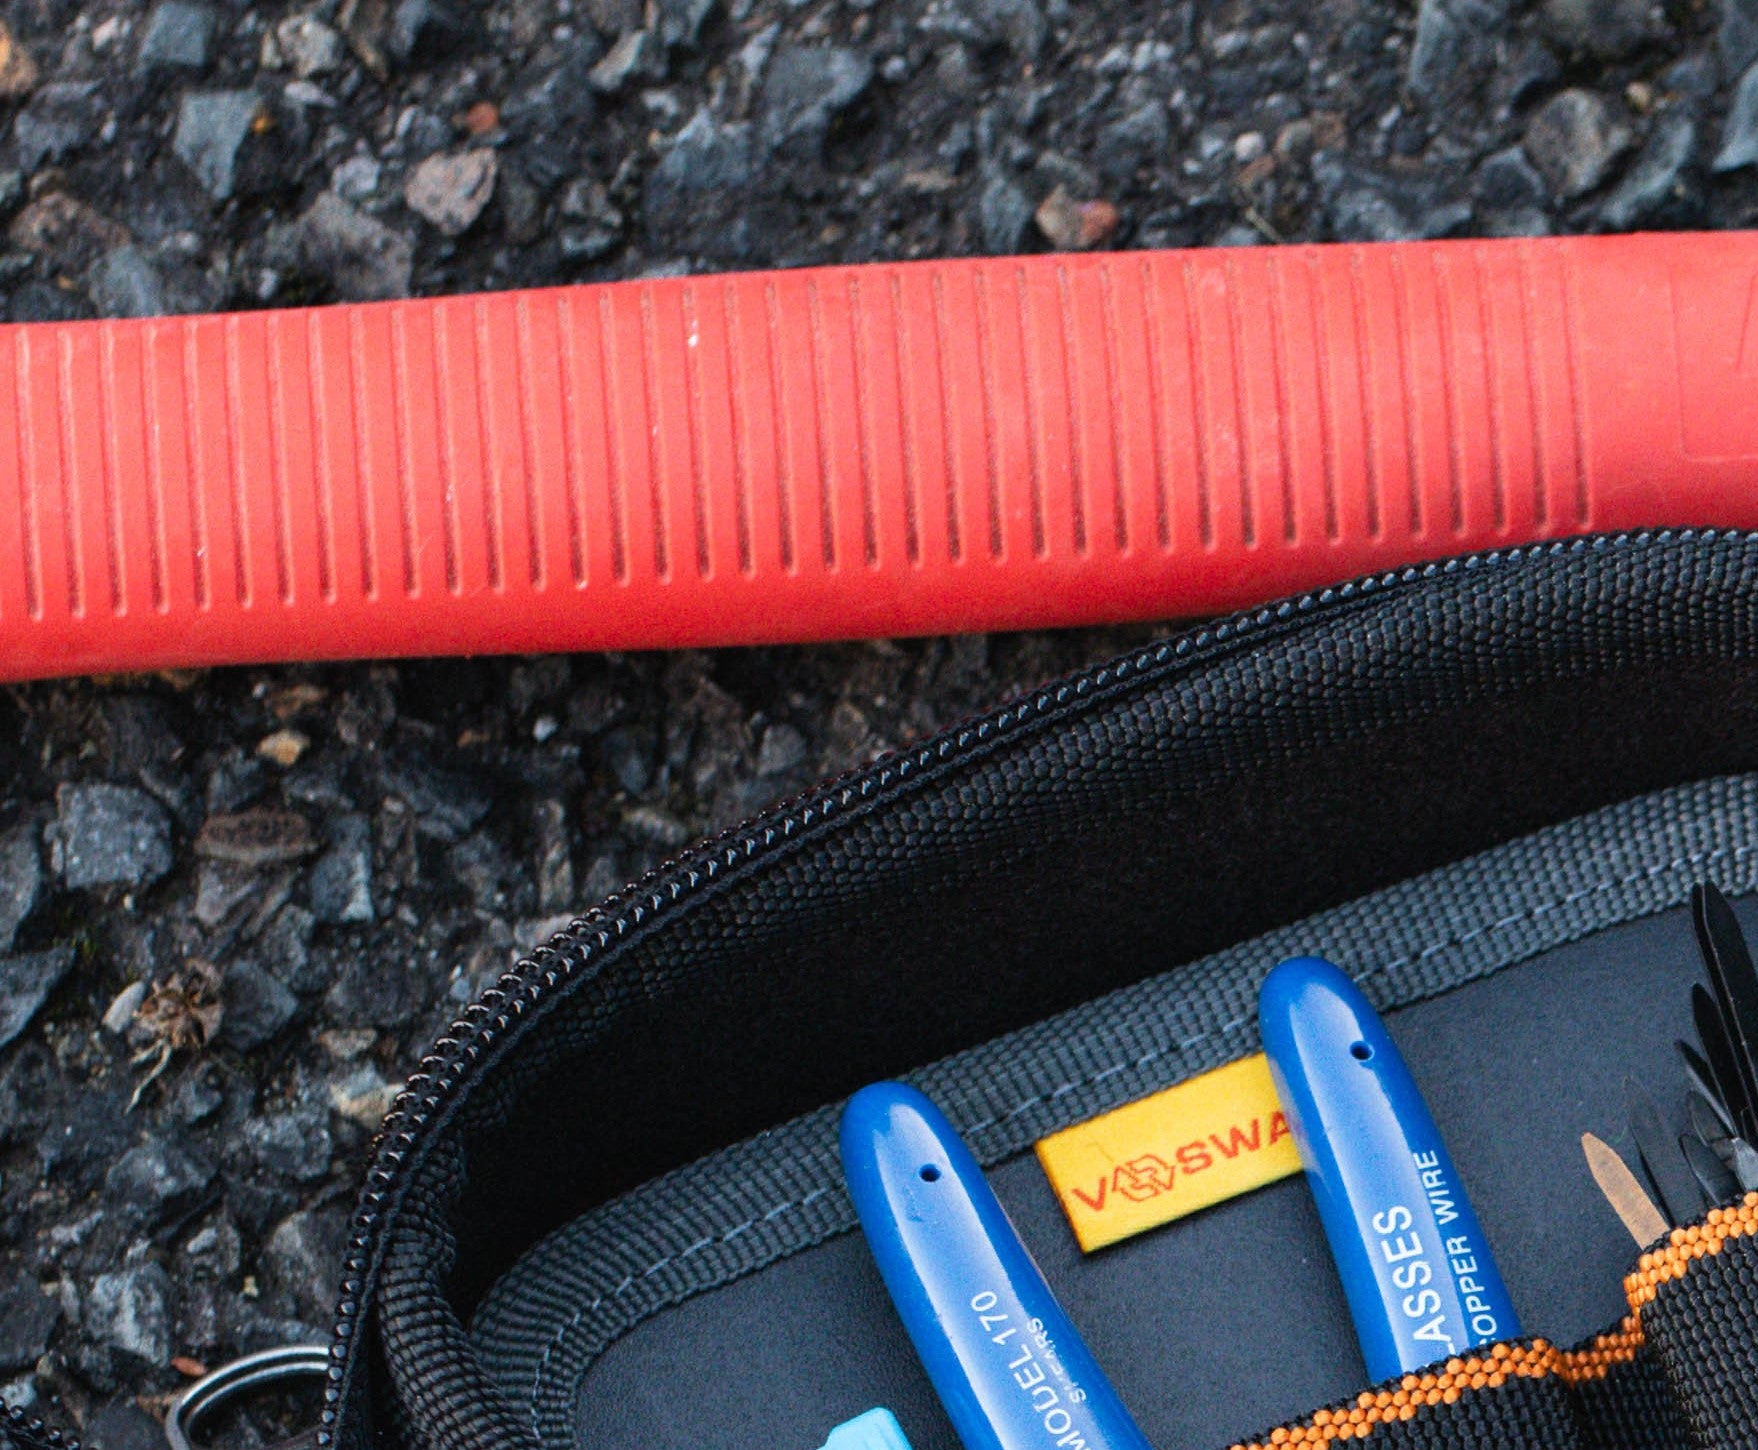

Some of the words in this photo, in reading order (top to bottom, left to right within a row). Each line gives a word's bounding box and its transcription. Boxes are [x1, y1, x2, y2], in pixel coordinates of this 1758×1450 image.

[1413, 1149, 1460, 1226] WIRE
[970, 1290, 1017, 1346] 170
[1446, 1235, 1498, 1345] OPPER
